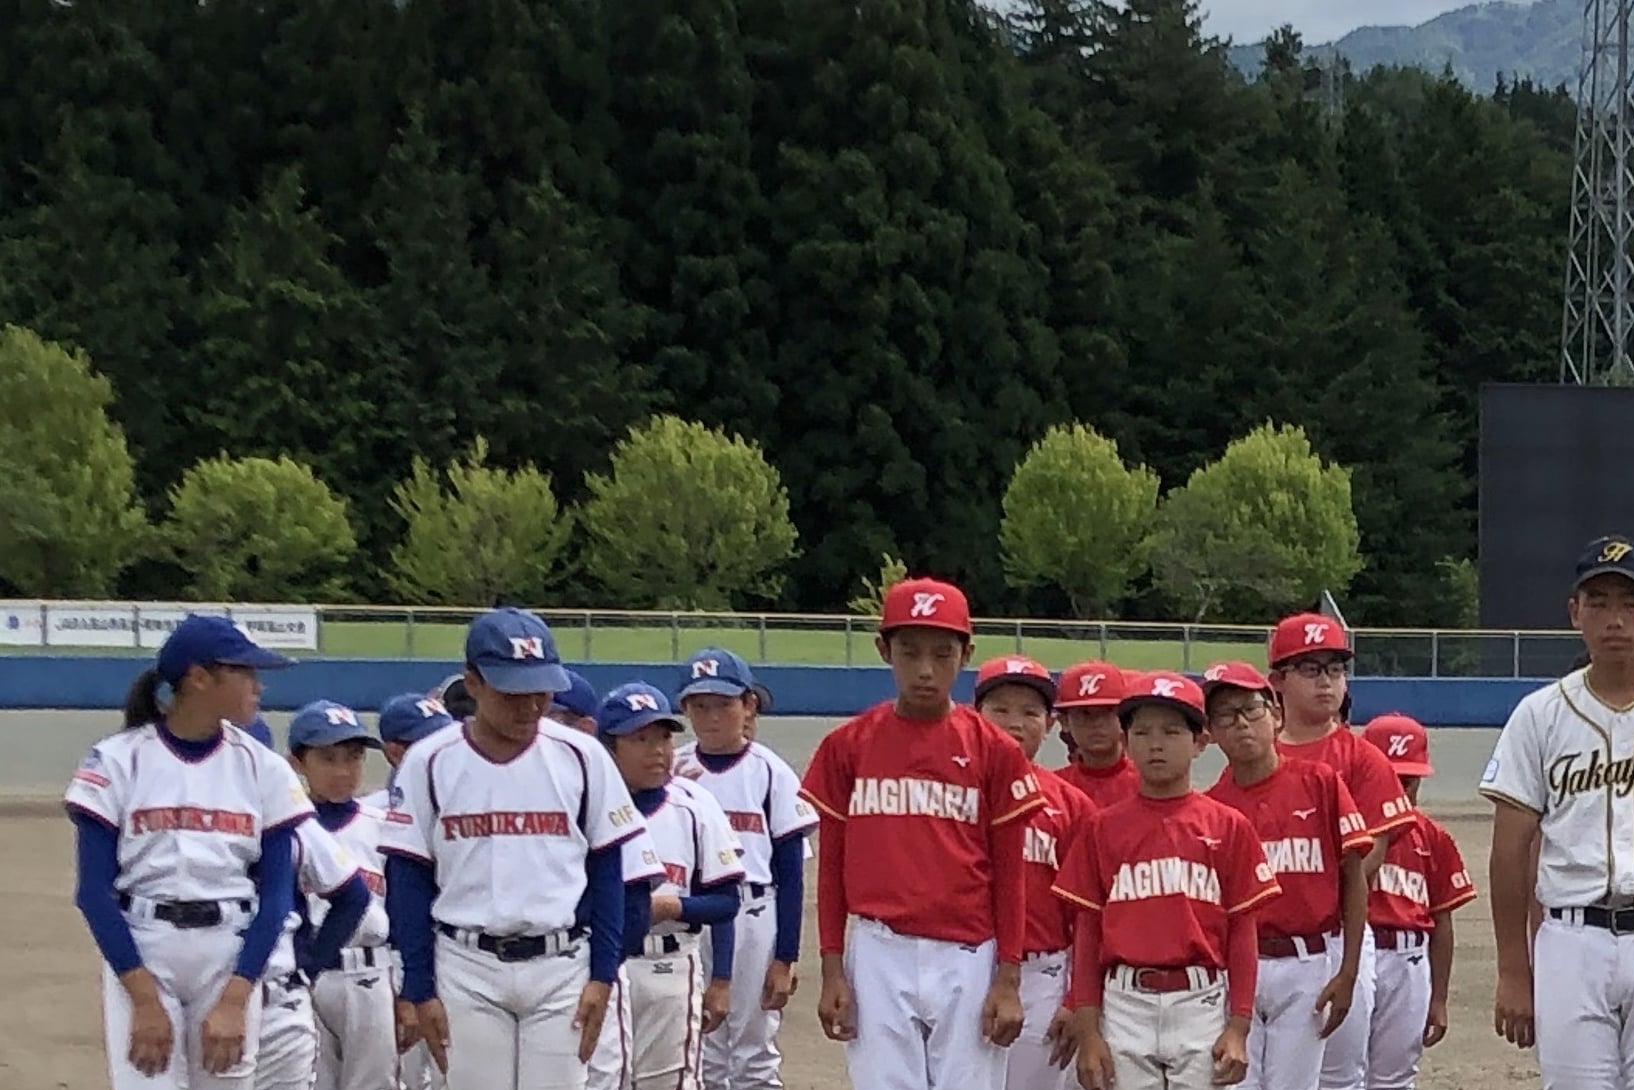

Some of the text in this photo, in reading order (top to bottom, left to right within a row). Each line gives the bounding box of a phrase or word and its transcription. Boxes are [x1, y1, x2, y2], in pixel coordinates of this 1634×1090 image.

[507, 636, 546, 660] N
[690, 659, 720, 680] N
[626, 693, 659, 712] N
[324, 706, 359, 727] N
[442, 811, 571, 841] FURUKAWA
